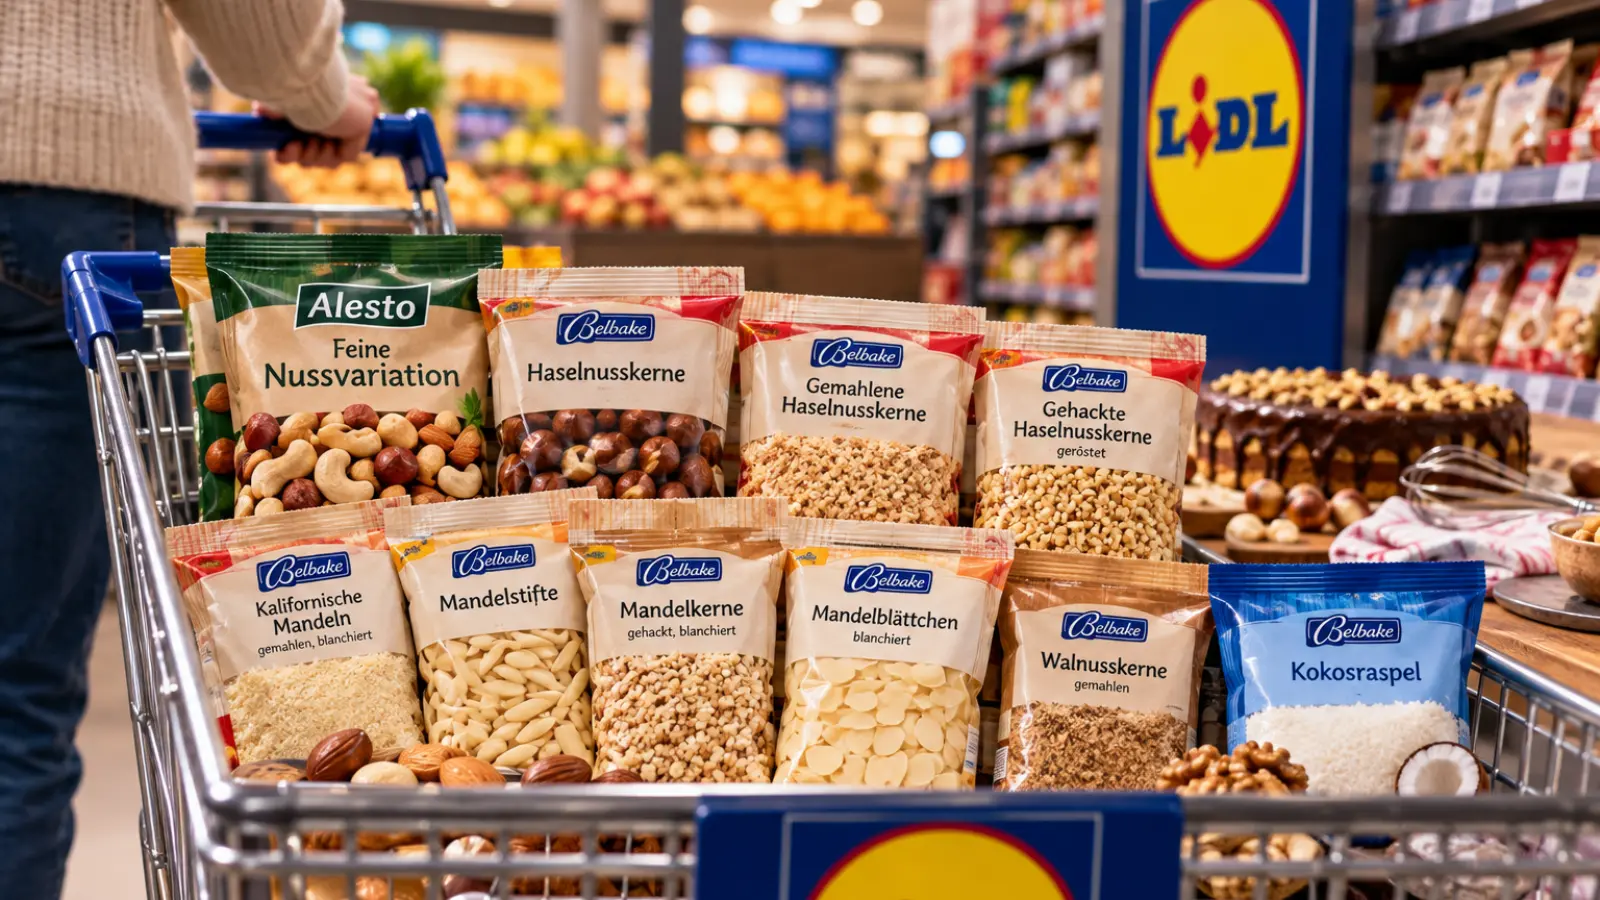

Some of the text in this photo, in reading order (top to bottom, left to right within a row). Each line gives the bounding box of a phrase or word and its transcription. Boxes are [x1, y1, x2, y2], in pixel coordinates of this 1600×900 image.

[307, 291, 416, 320] Alesto
[564, 312, 647, 343] Belbake
[332, 338, 391, 359] Feine
[818, 339, 896, 364] Belbake
[264, 362, 460, 389] Nussvariation
[527, 361, 685, 382] Haselnusskerne
[1049, 365, 1121, 389] Belbake
[806, 377, 904, 399] Gemahlene
[782, 396, 927, 422] Haselnusskerne
[1042, 401, 1126, 421] Gehackte
[1014, 421, 1152, 445] Haselnusskerne
[1056, 446, 1106, 459] geröstet
[266, 555, 344, 589] Belbake
[459, 547, 530, 576] Belbake
[643, 555, 716, 584] Belbake
[850, 564, 925, 591] Belbake
[255, 589, 363, 617] Kalifornische
[440, 584, 559, 612] Mandelstifte
[620, 600, 744, 619] Mandelkerne
[273, 612, 352, 636] Mandeln
[812, 604, 958, 630] Mandelblättchen
[1068, 612, 1142, 637] Belbake
[627, 625, 736, 641] gehackt, blanchiert
[852, 631, 911, 646] blanchiert
[1313, 615, 1394, 645] Belbake
[257, 629, 373, 658] gemahlen, blanchiert
[1041, 651, 1168, 679] Walnusskerne
[1291, 661, 1422, 686] Kokosraspel
[1074, 680, 1130, 694] gemahlen
